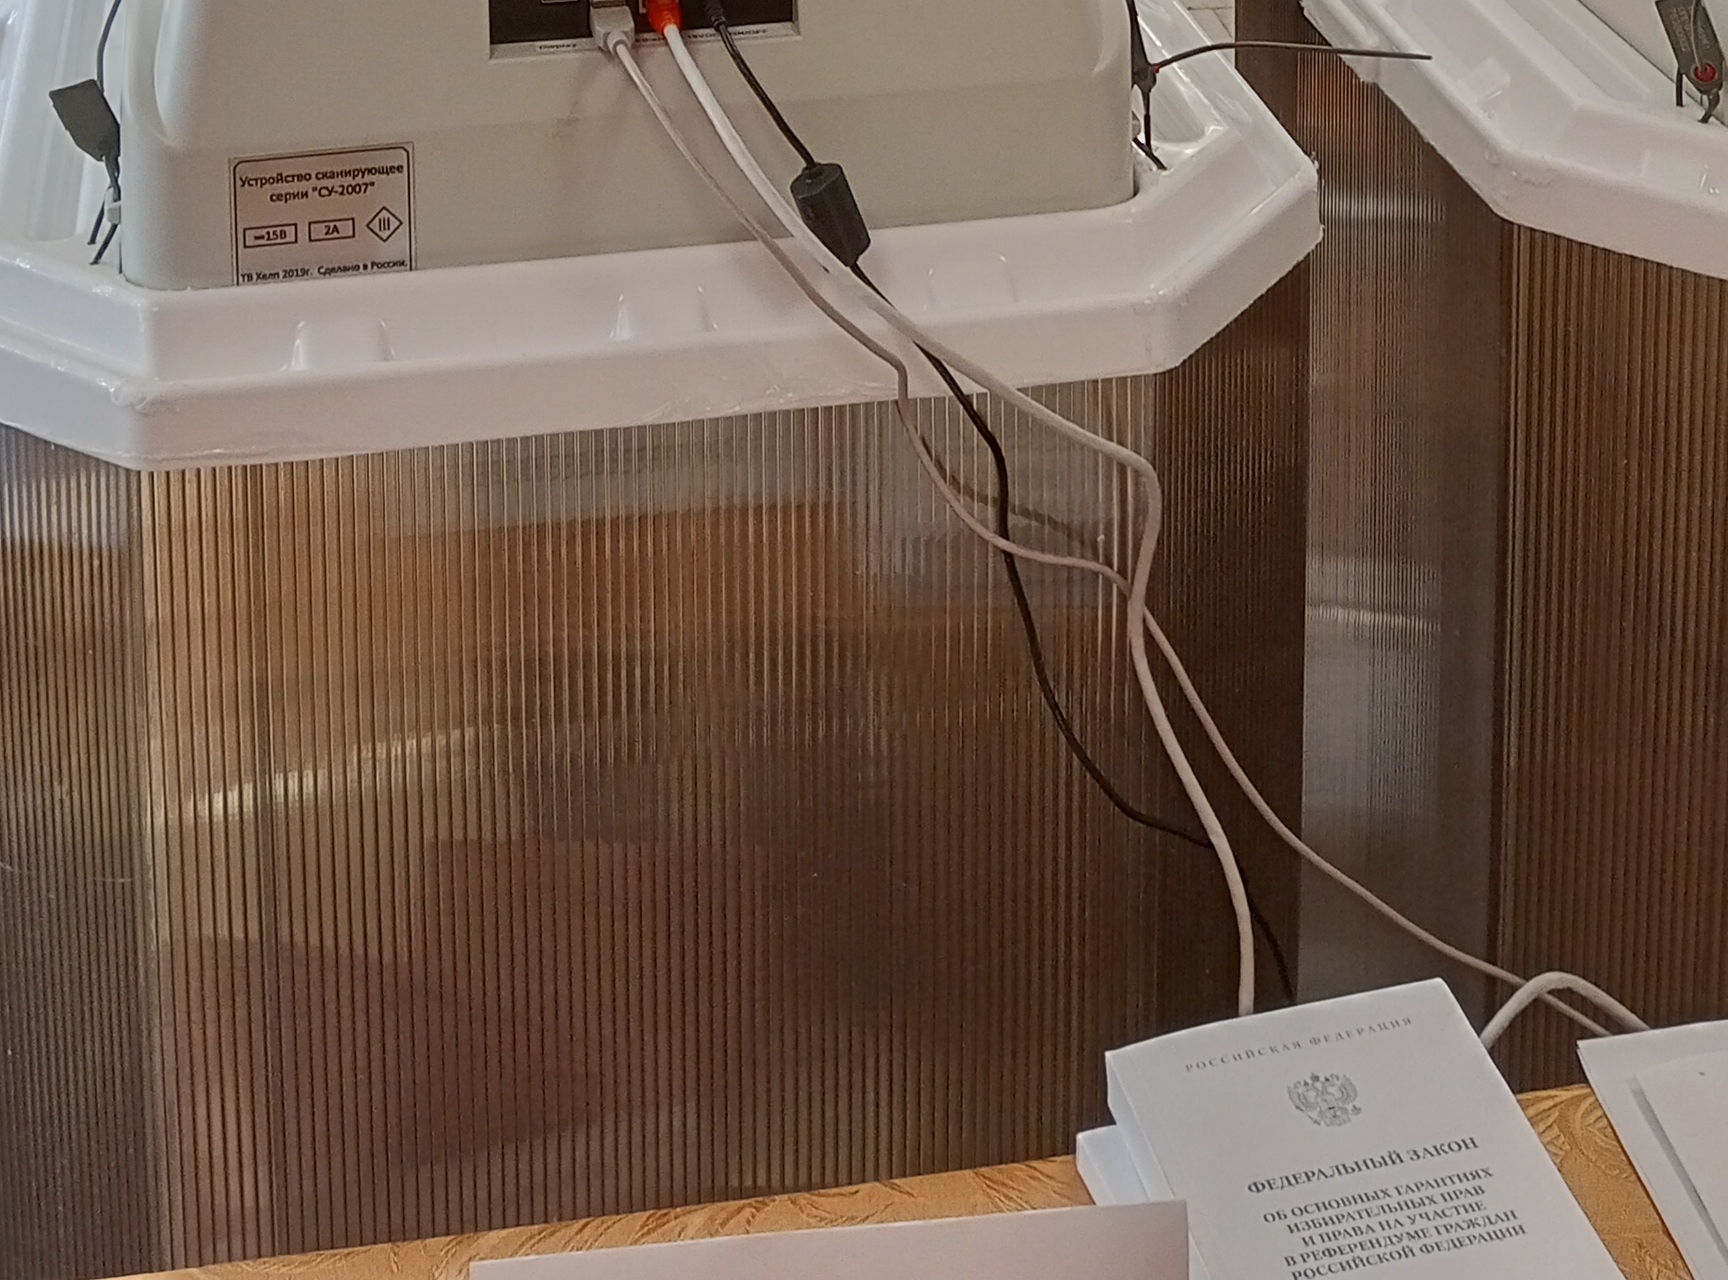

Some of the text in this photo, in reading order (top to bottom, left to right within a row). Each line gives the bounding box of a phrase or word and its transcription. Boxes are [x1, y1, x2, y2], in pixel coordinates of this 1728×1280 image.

[239, 164, 404, 188] Устройство сканирующее
[270, 182, 375, 204] серии "СУ-2007"
[241, 272, 254, 283] ТВ
[317, 264, 361, 277] Сделано
[362, 263, 368, 271] в
[370, 259, 408, 270] России.
[1185, 1016, 1413, 1073] РОССИЙСКАЯ ФЕДЕРАЦИЯ
[1247, 1137, 1479, 1194] ФЕДЕРАЛЬНЫЙ ЗАКОН
[1263, 1167, 1494, 1224] ОБ ОСНОВНЫХ ГАРАНТИЯХ
[1287, 1185, 1486, 1235] ИЗБИРАТЕЛЬНЫХ ПРАВ
[1284, 1209, 1519, 1267] В РЕФЕРЕНДУМЕ ГРАЖДАН
[1301, 1200, 1487, 1247] И ПРАВА НА УЧАСТИЕ
[1291, 1224, 1527, 1280] РОССИЙСКОЙ ФЕДЕРАЦИИ
